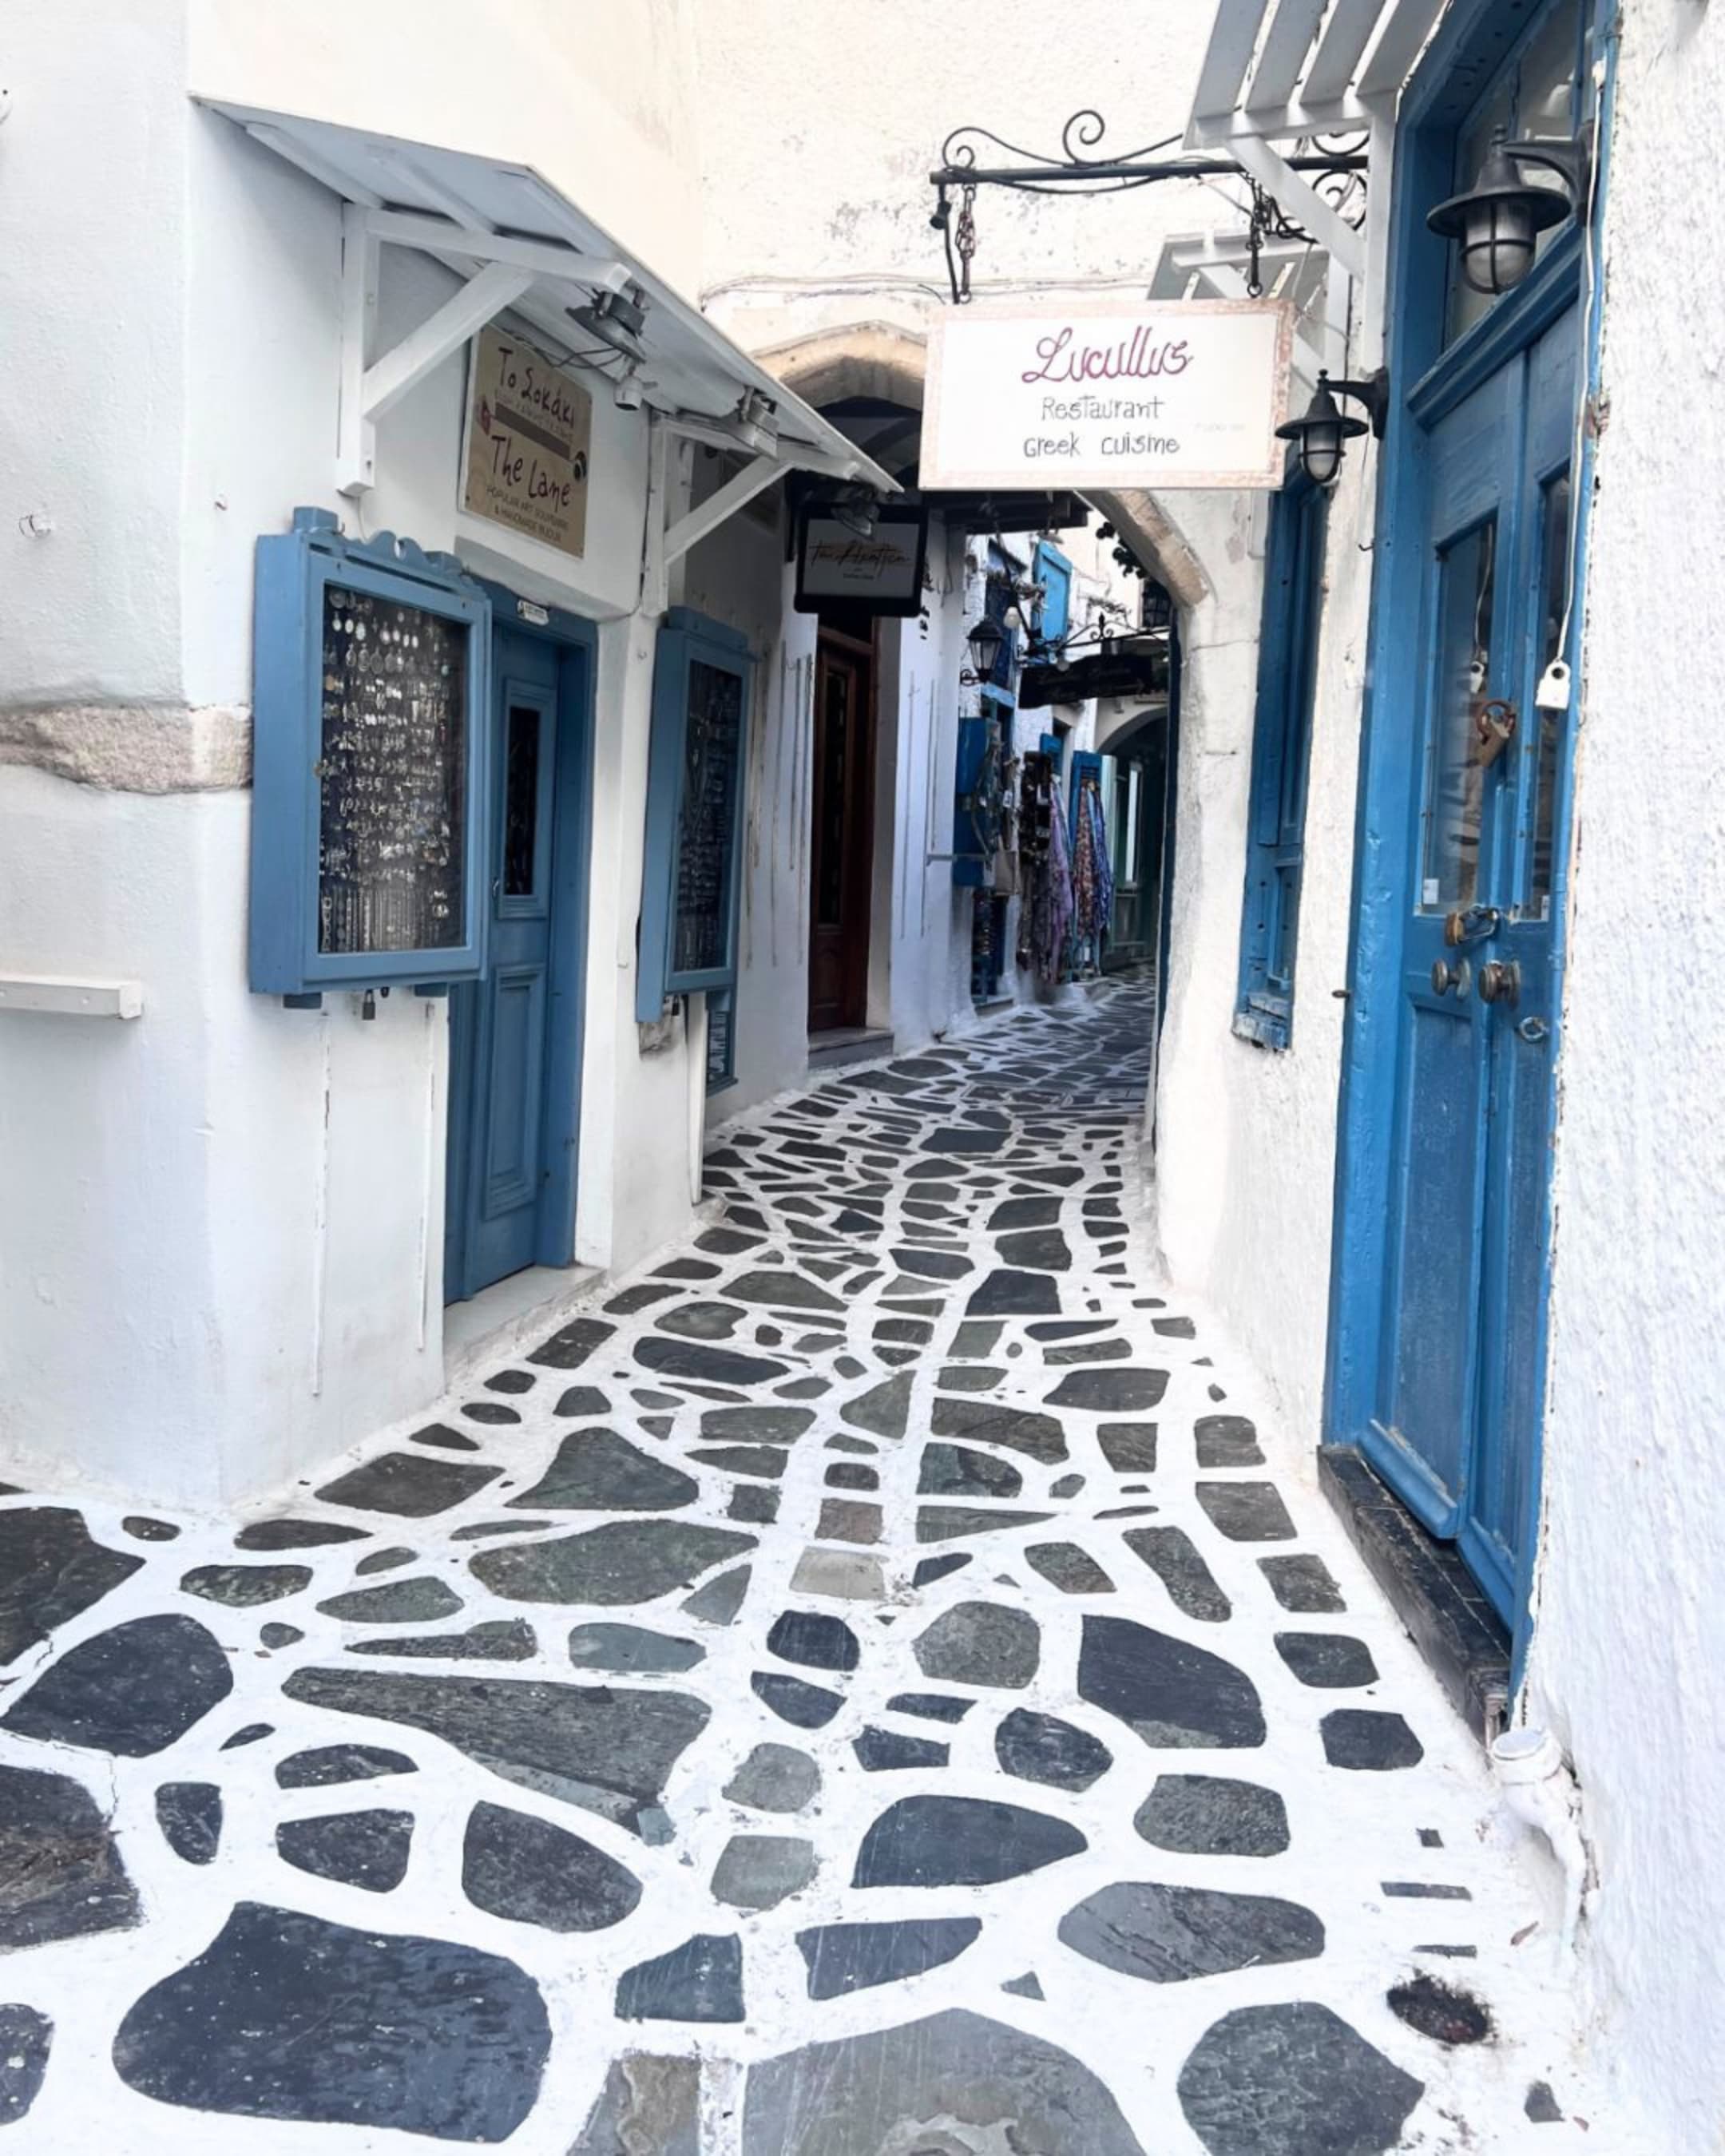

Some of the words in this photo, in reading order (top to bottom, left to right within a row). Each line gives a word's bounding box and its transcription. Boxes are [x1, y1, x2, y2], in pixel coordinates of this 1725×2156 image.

[1021, 325, 1194, 383] Lucullus
[1041, 395, 1164, 421] Restaurant
[1024, 432, 1081, 458] Greek
[491, 435, 523, 486] The
[528, 459, 570, 513] Lane
